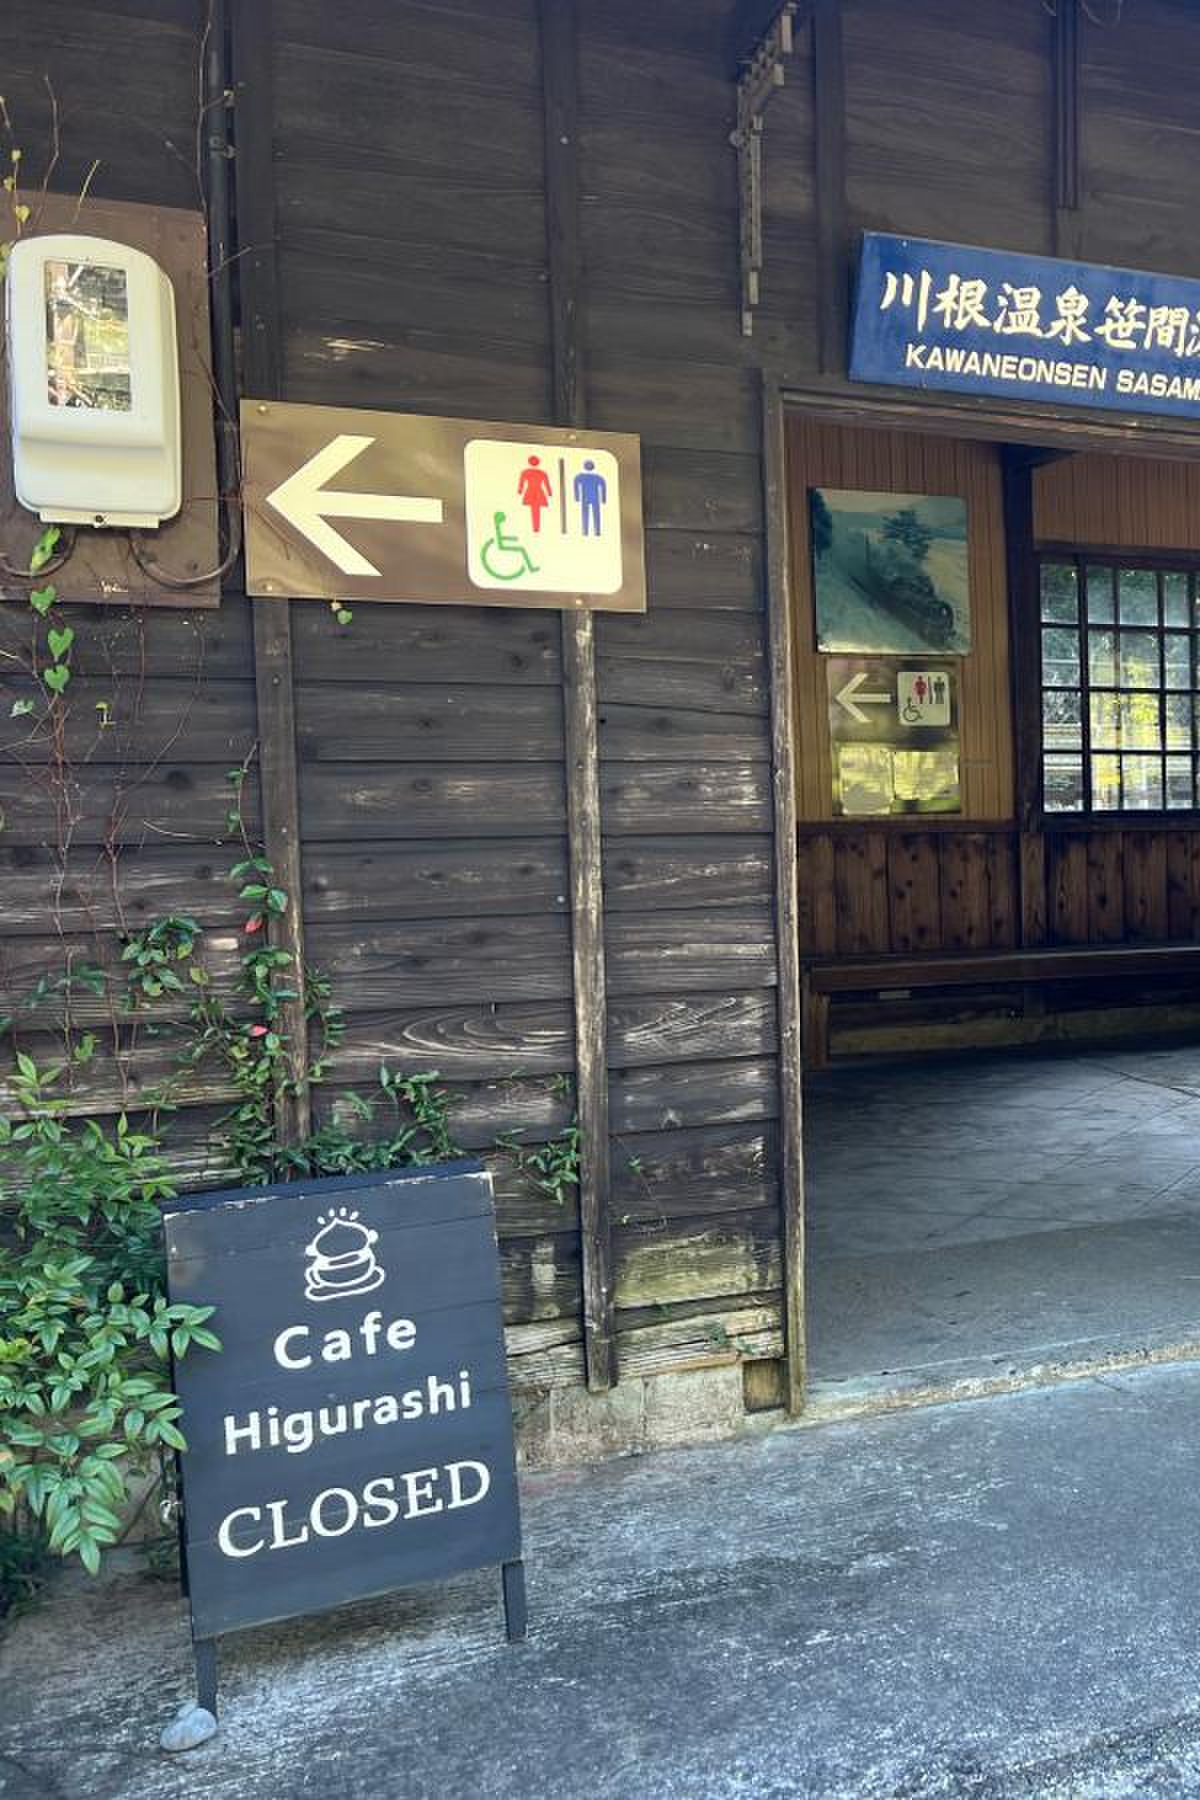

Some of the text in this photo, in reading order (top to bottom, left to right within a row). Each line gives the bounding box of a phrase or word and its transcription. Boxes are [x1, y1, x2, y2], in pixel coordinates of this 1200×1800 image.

[905, 343, 1108, 389] KAWANEONSEN
[273, 1311, 416, 1369] Cafe
[224, 1370, 472, 1455] Higurashi
[217, 1459, 491, 1558] CLOSED
